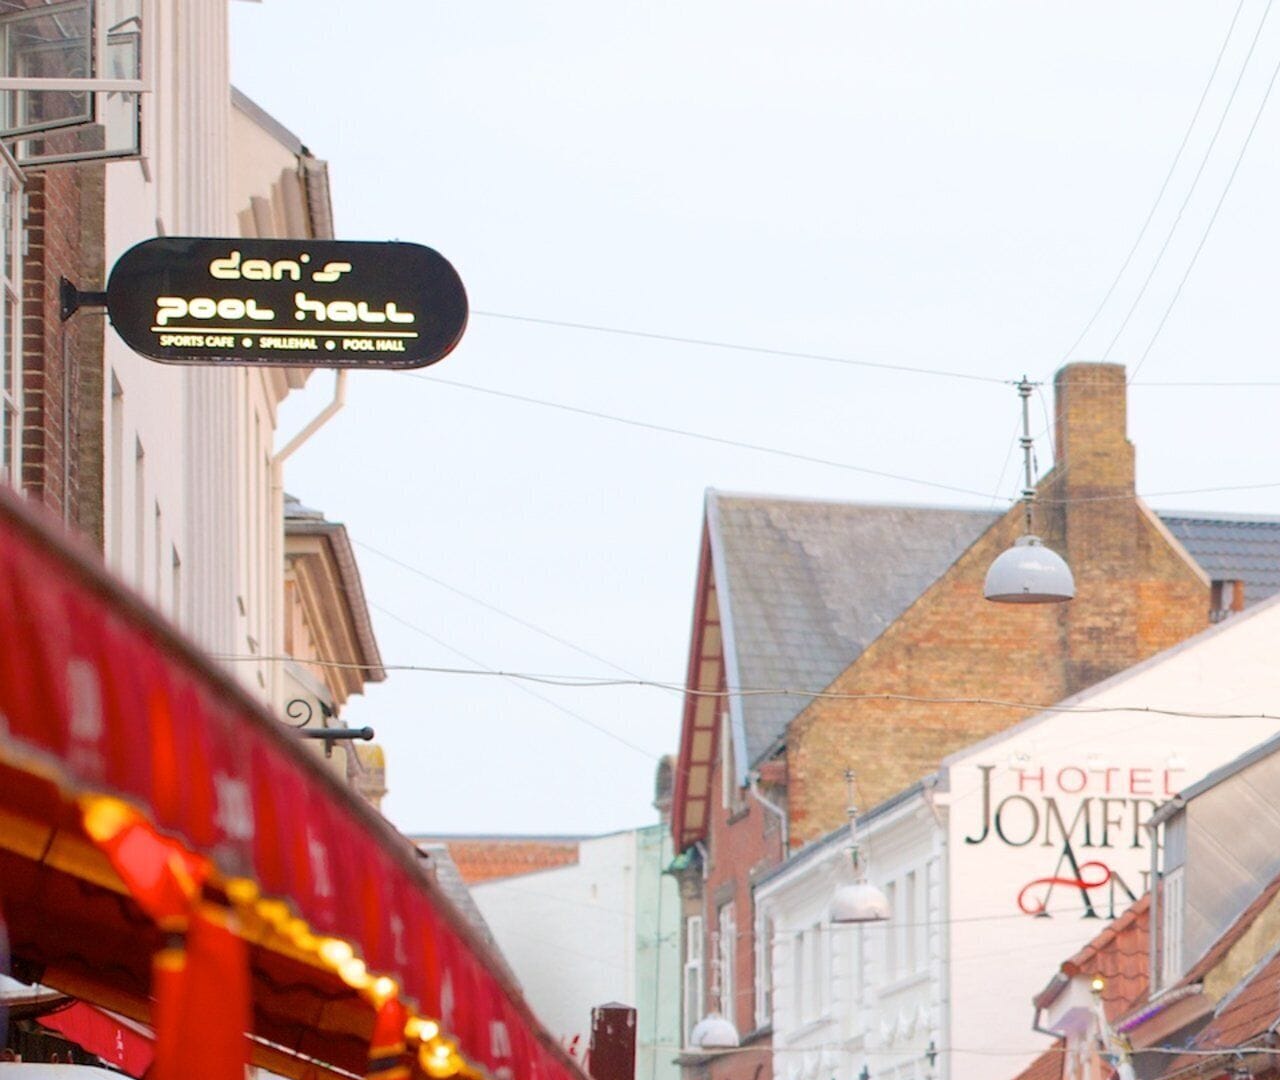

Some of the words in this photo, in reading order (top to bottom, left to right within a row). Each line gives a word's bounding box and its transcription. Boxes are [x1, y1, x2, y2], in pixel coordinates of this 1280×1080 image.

[160, 335, 204, 347] SPORTS
[205, 336, 234, 348] CAFE
[259, 337, 317, 349] SPILLEHAL
[343, 339, 375, 351] POOL
[376, 340, 405, 351] HALL
[964, 764, 1165, 848] JOMFR
[1017, 767, 1187, 796] HOTEL
[1017, 840, 1156, 920] AN
